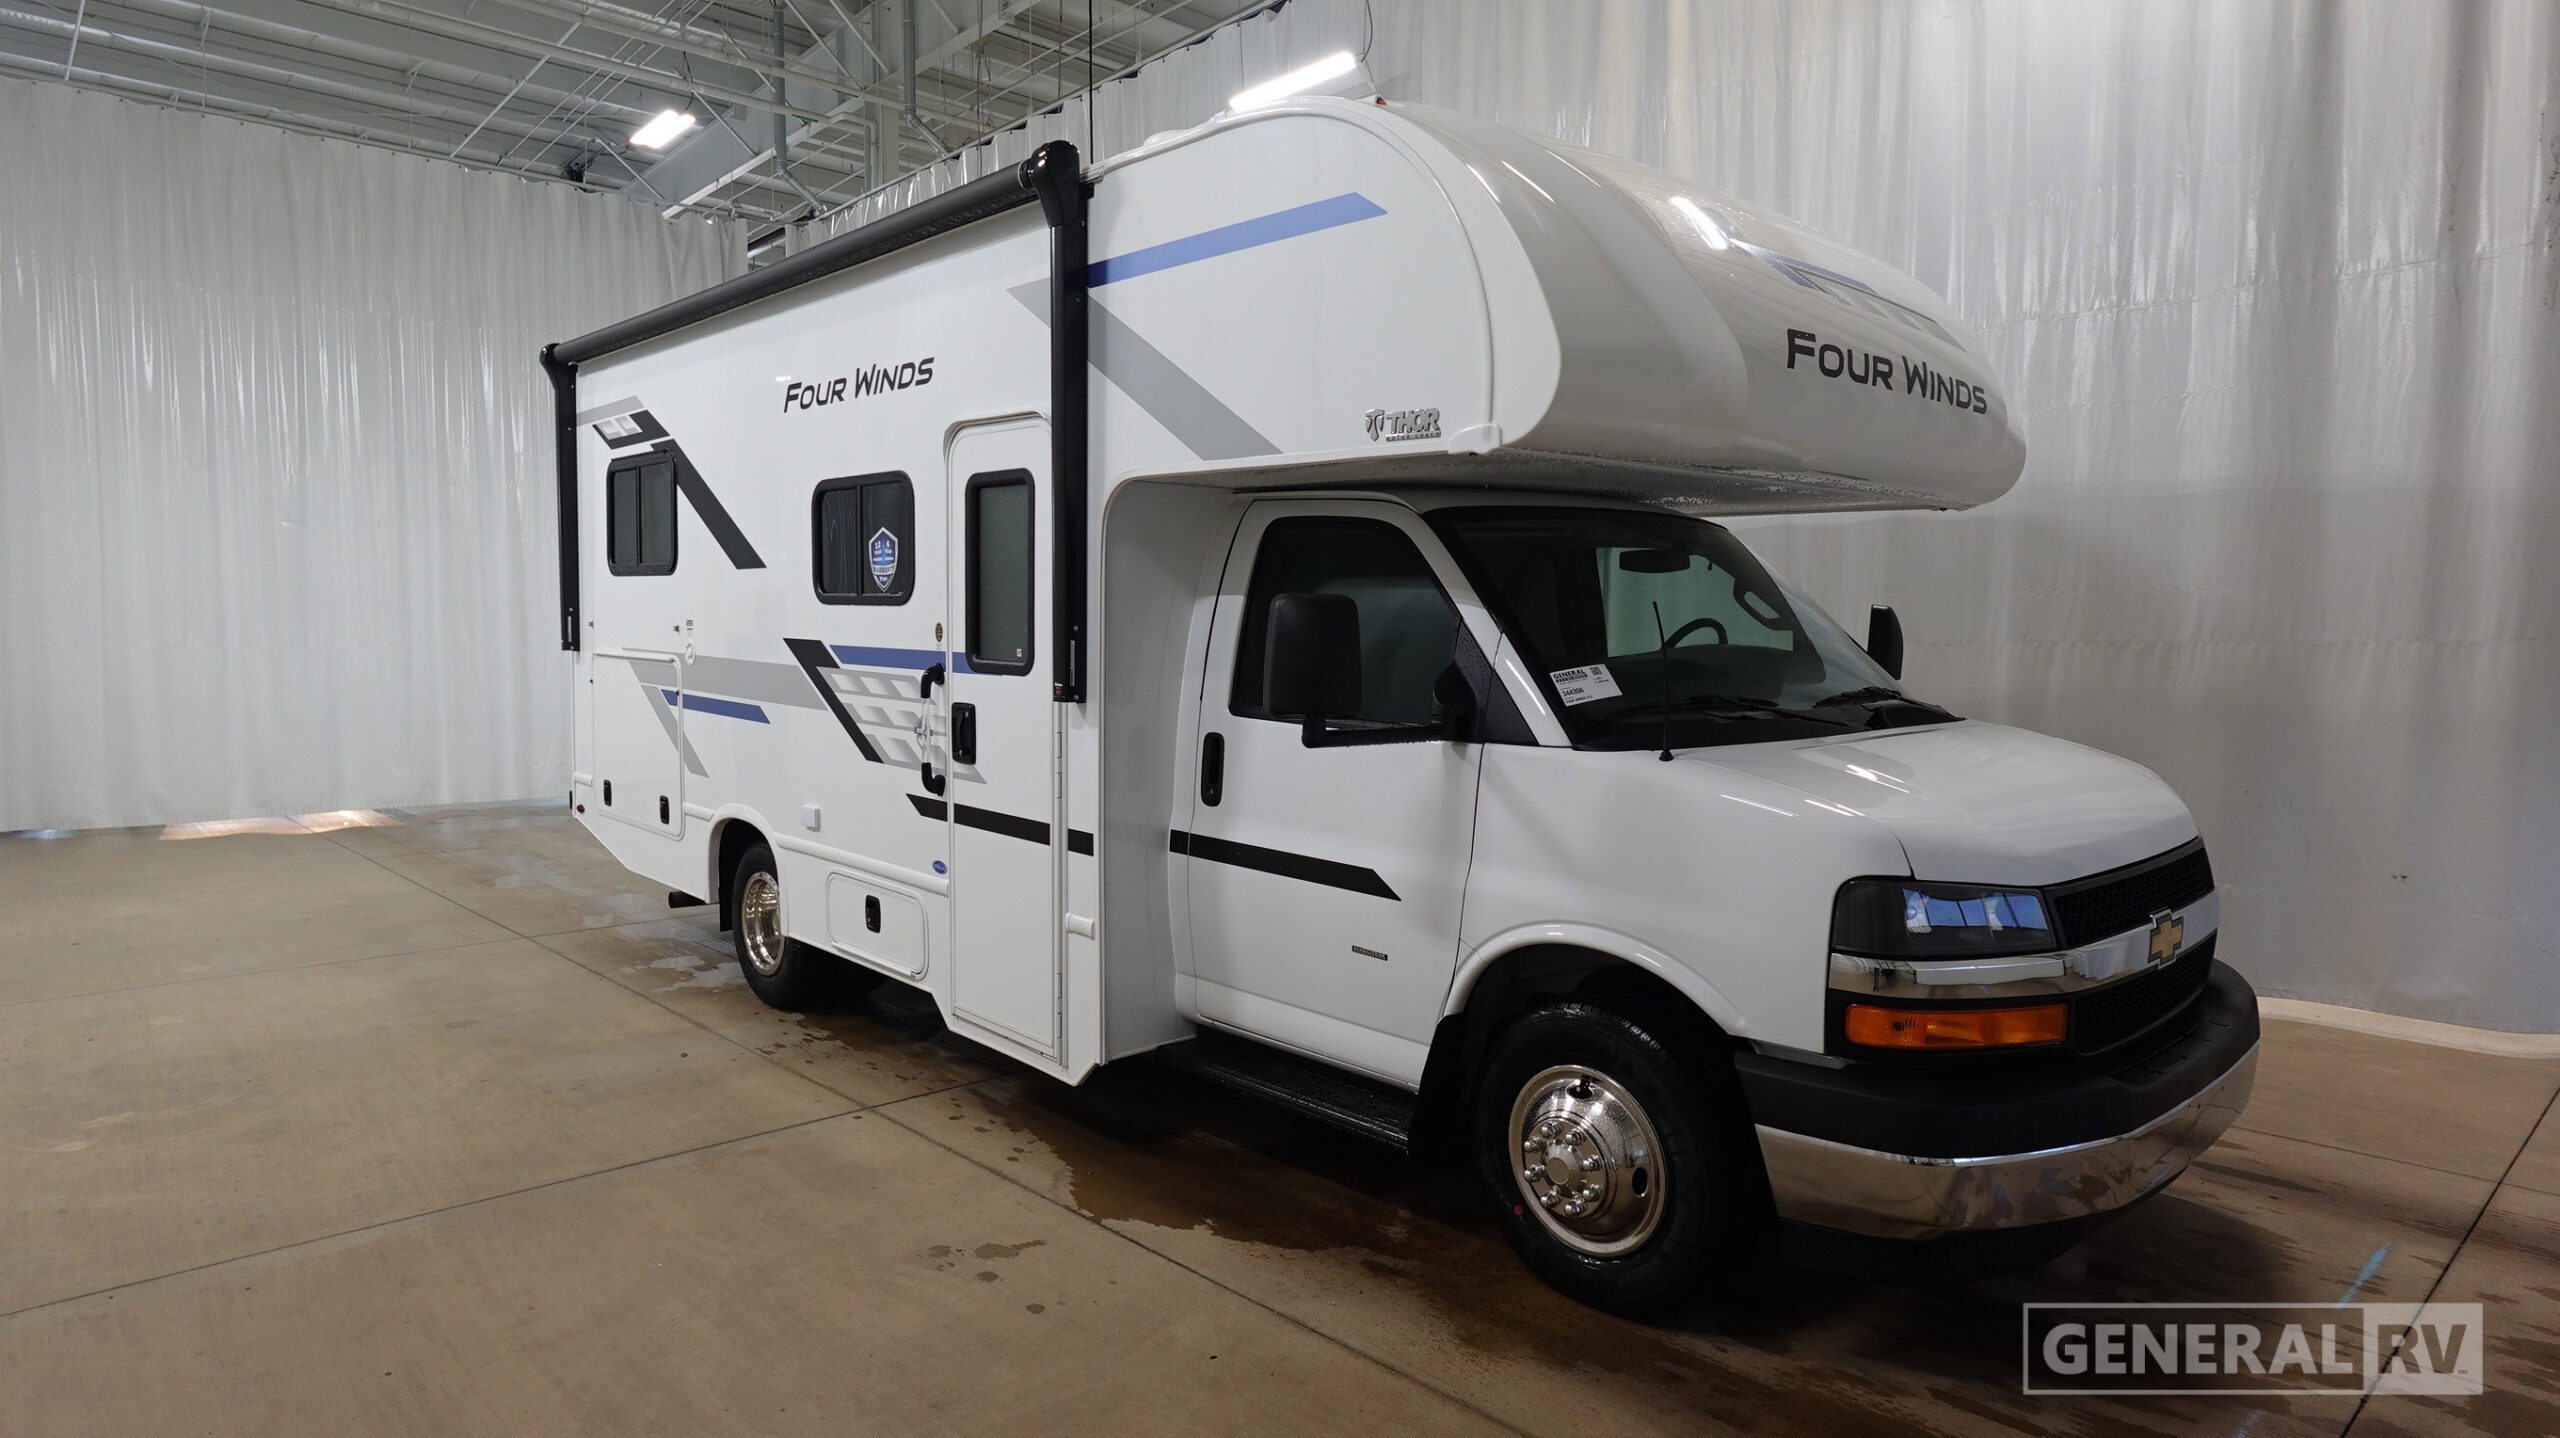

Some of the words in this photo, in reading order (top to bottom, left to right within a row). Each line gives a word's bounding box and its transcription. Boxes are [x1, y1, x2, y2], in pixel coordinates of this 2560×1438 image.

[783, 376, 847, 413] FOUR
[854, 357, 935, 399] WINDS
[1786, 328, 1894, 391] FOUR
[1901, 355, 1988, 415] WINDS
[1386, 408, 1441, 434] THOR
[1553, 669, 1586, 679] GENERAL
